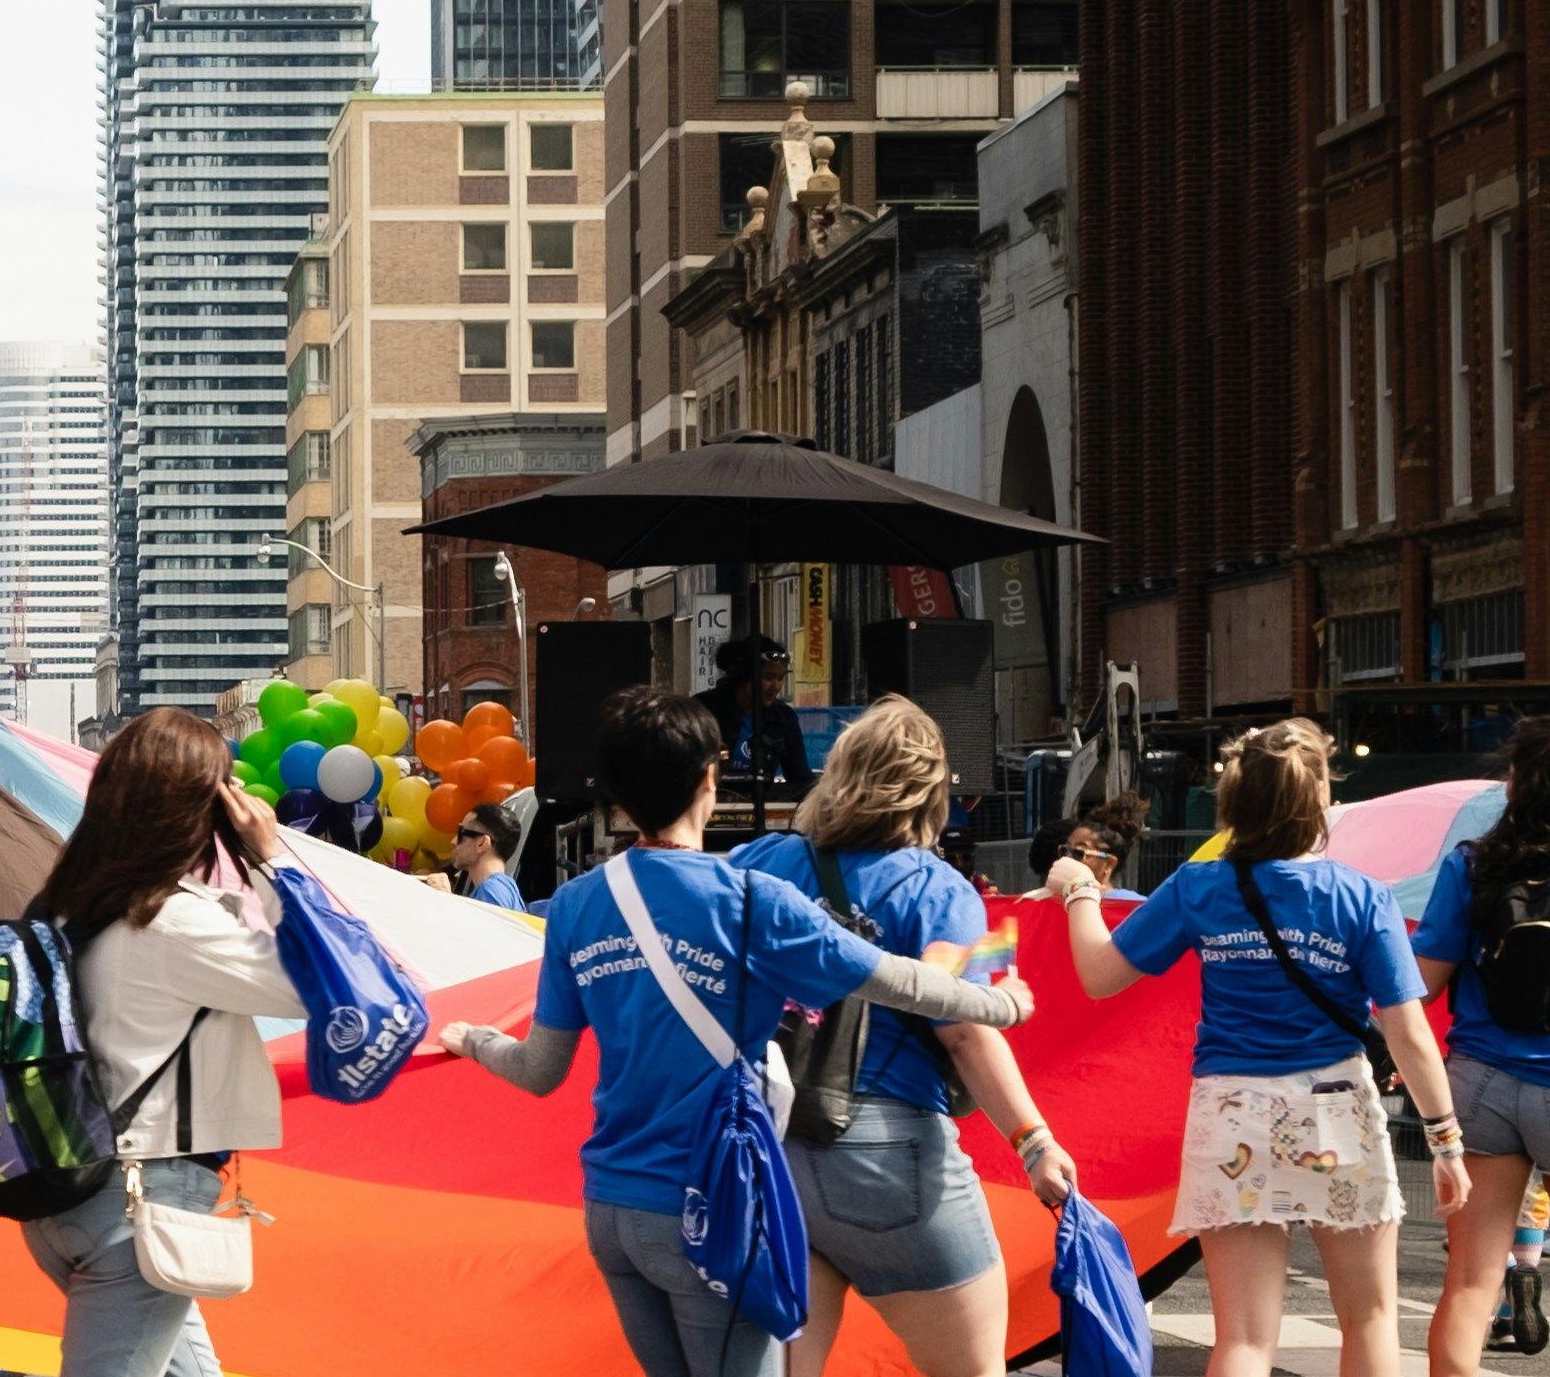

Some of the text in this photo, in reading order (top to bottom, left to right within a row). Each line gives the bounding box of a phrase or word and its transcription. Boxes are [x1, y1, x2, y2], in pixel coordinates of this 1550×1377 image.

[698, 609, 728, 628] nc
[1001, 578, 1027, 628] fido
[699, 636, 707, 676] HAIR
[675, 939, 725, 972] Pride
